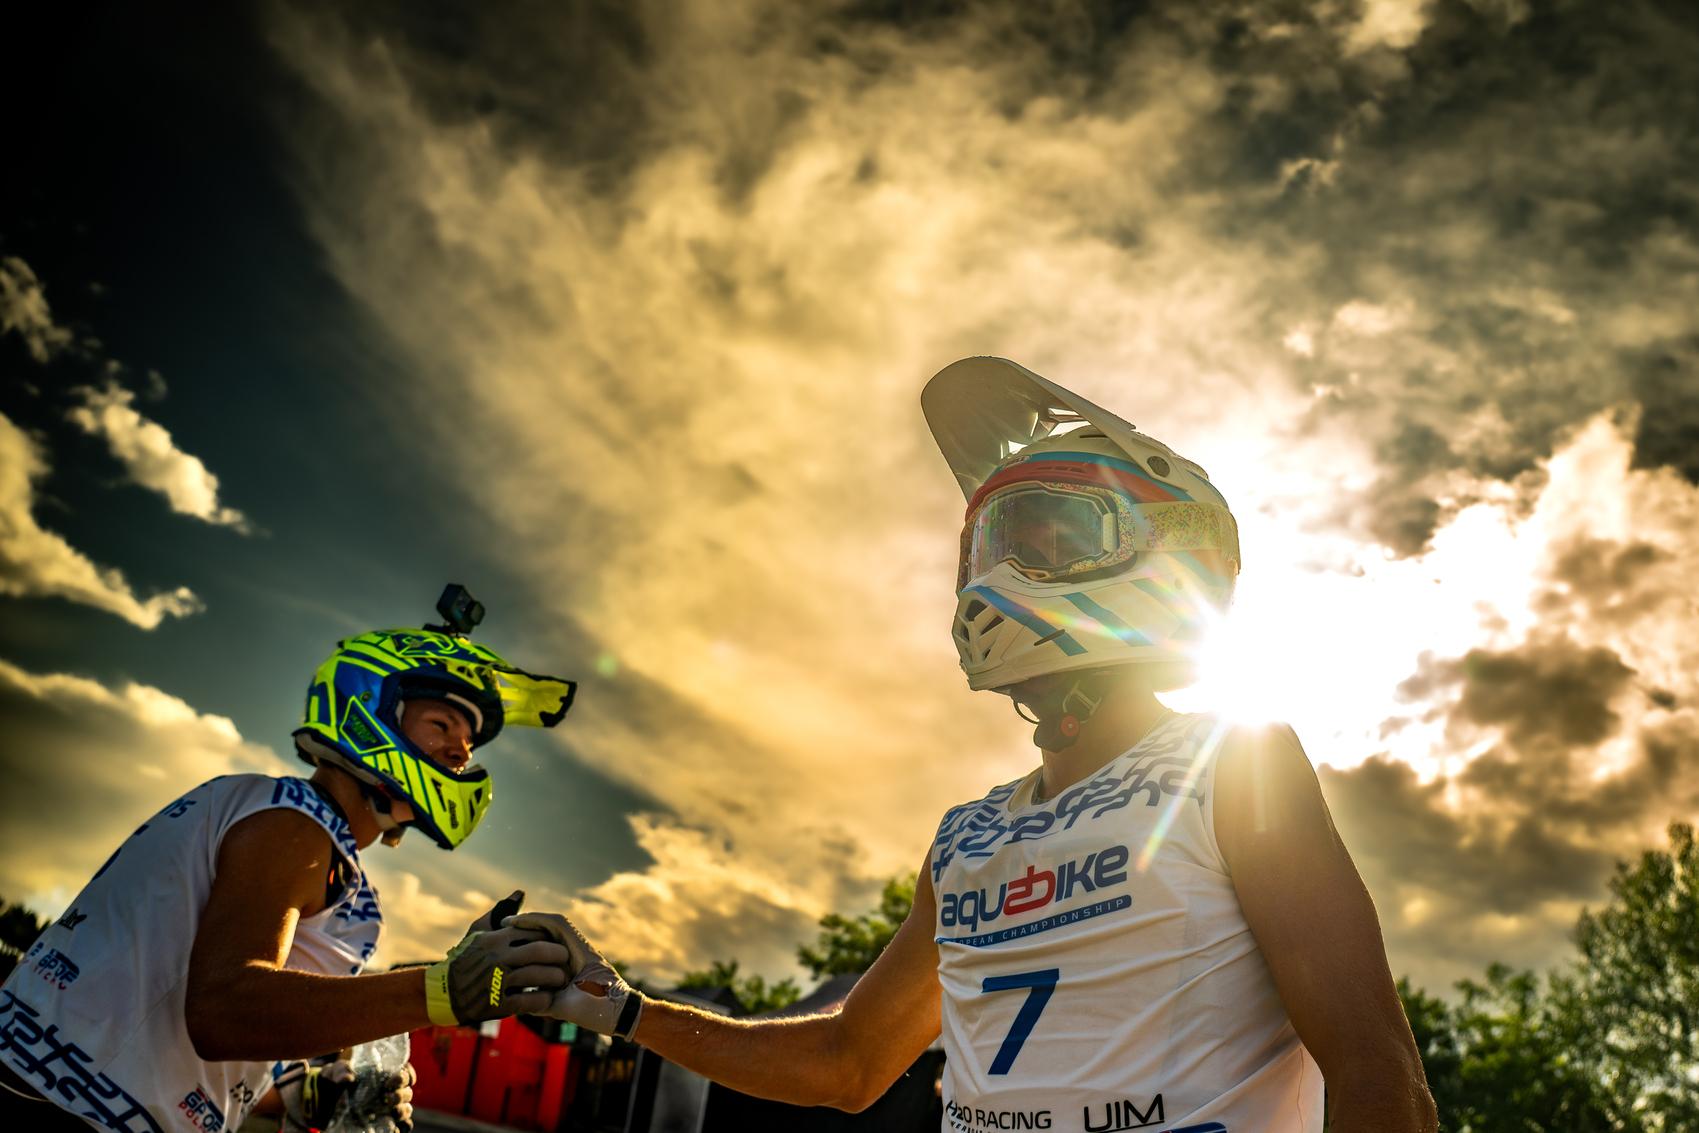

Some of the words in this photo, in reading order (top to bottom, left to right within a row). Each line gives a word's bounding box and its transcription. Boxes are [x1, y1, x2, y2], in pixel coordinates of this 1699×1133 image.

[1002, 899, 1125, 940] CHAMPIONSHIP
[489, 966, 504, 1007] THOR
[981, 968, 1060, 1076] 7
[975, 1109, 1052, 1130] RACING
[1083, 1093, 1165, 1133] UIM
